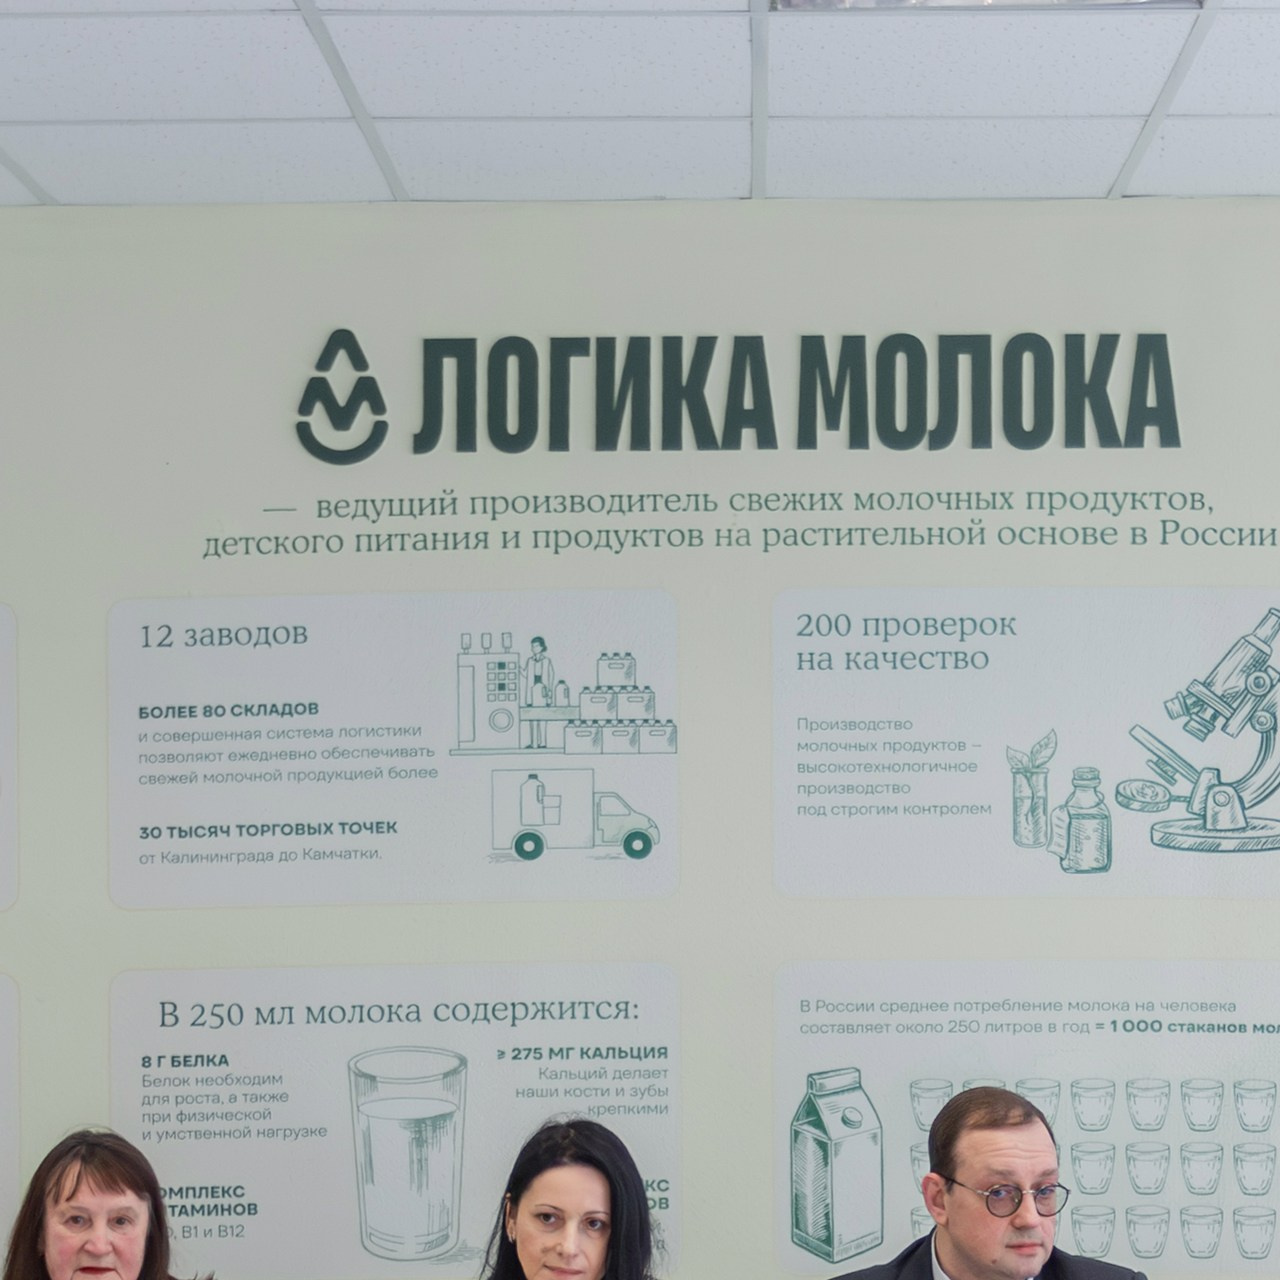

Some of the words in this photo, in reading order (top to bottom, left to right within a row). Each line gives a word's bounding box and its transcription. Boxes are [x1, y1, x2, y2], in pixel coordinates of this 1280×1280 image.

[411, 334, 779, 456] ЛОГИКА
[795, 331, 1182, 452] МОЛОКА
[317, 489, 457, 522] ведущий
[470, 493, 718, 521] производитель
[729, 493, 843, 511] свежих
[854, 492, 1013, 519] молочных
[1027, 491, 1213, 516] продуктов,
[203, 535, 344, 559] детского
[356, 531, 489, 553] питания
[502, 531, 520, 549] и
[533, 528, 704, 555] продуктов
[716, 528, 751, 546] на
[763, 519, 985, 553] растительной
[998, 526, 1118, 546] основе
[1131, 526, 1147, 545] в
[1160, 519, 1277, 546] России
[797, 614, 851, 637] 200
[863, 617, 1016, 640] проверок
[142, 624, 173, 648] 12
[184, 625, 308, 648] заводов
[797, 652, 833, 671] на
[845, 651, 989, 670] качество
[139, 705, 197, 719] БОЛЕЕ
[203, 704, 226, 718] 80
[230, 702, 319, 718] СКЛАДОВ
[797, 717, 913, 733] Производство
[138, 733, 148, 743] и
[152, 730, 261, 744] совершенная
[267, 728, 334, 740] система
[339, 726, 422, 737] логистики
[139, 752, 223, 764] позволяют
[228, 750, 317, 762] ежедневно
[321, 747, 435, 760] обеспечивать
[797, 742, 877, 752] молочных
[883, 741, 966, 755] продуктов
[138, 771, 198, 785] свежей
[203, 769, 282, 784] молочной
[287, 767, 383, 784] продукцией
[388, 766, 438, 779] более
[797, 762, 978, 774] высокотехнологичное
[797, 783, 911, 797] производство
[797, 806, 827, 817] под
[831, 805, 898, 818] строгим
[903, 804, 992, 818] контролем
[140, 826, 162, 840] 30
[166, 825, 230, 839] ТЫСЯЧ
[236, 822, 333, 837] ТОРГОВЫХ
[338, 820, 397, 835] ТОЧЕК
[139, 854, 155, 865] от
[161, 851, 274, 865] Калининграда
[278, 851, 298, 863] до
[303, 848, 382, 861] Камчатки.
[160, 1002, 179, 1027] В
[190, 1003, 244, 1029] 250
[255, 1006, 294, 1025] мл
[306, 1003, 421, 1024] молока
[433, 1001, 638, 1027] содержится:
[800, 999, 811, 1013] В
[816, 999, 875, 1013] России
[879, 1002, 949, 1015] среднее
[954, 999, 1063, 1014] потребление
[1068, 1001, 1130, 1012] молока
[1135, 1001, 1155, 1012] на
[1160, 1002, 1236, 1012] человека
[800, 1023, 891, 1034] составляет
[895, 1024, 944, 1034] около
[948, 1019, 980, 1033] 250
[984, 1022, 1043, 1035] литров
[1048, 1022, 1057, 1033] в
[1062, 1023, 1090, 1034] год
[1167, 1023, 1247, 1033] стаканов
[142, 1056, 152, 1068] 8
[157, 1055, 166, 1068] Г
[171, 1054, 229, 1068] БЕЛКА
[511, 1047, 543, 1061] 275
[549, 1047, 575, 1060] МГ
[580, 1046, 668, 1060] КАЛЬЦИЯ
[142, 1074, 190, 1088] Белок
[195, 1073, 283, 1087] необходим
[539, 1066, 607, 1081] Кальций
[612, 1069, 668, 1080] делает
[141, 1095, 169, 1107] для
[175, 1094, 224, 1107] роста,
[228, 1094, 237, 1104] а
[242, 1092, 289, 1103] также
[515, 1088, 559, 1098] наши
[564, 1087, 610, 1097] кости
[615, 1088, 625, 1097] и
[630, 1084, 669, 1099] зубы
[142, 1112, 171, 1125] при
[176, 1108, 271, 1125] физической
[588, 1103, 669, 1116] крепкими
[142, 1131, 151, 1141] и
[156, 1126, 251, 1143] умственной
[257, 1127, 327, 1140] нагрузке
[168, 1203, 258, 1217] ТАМИНОВ
